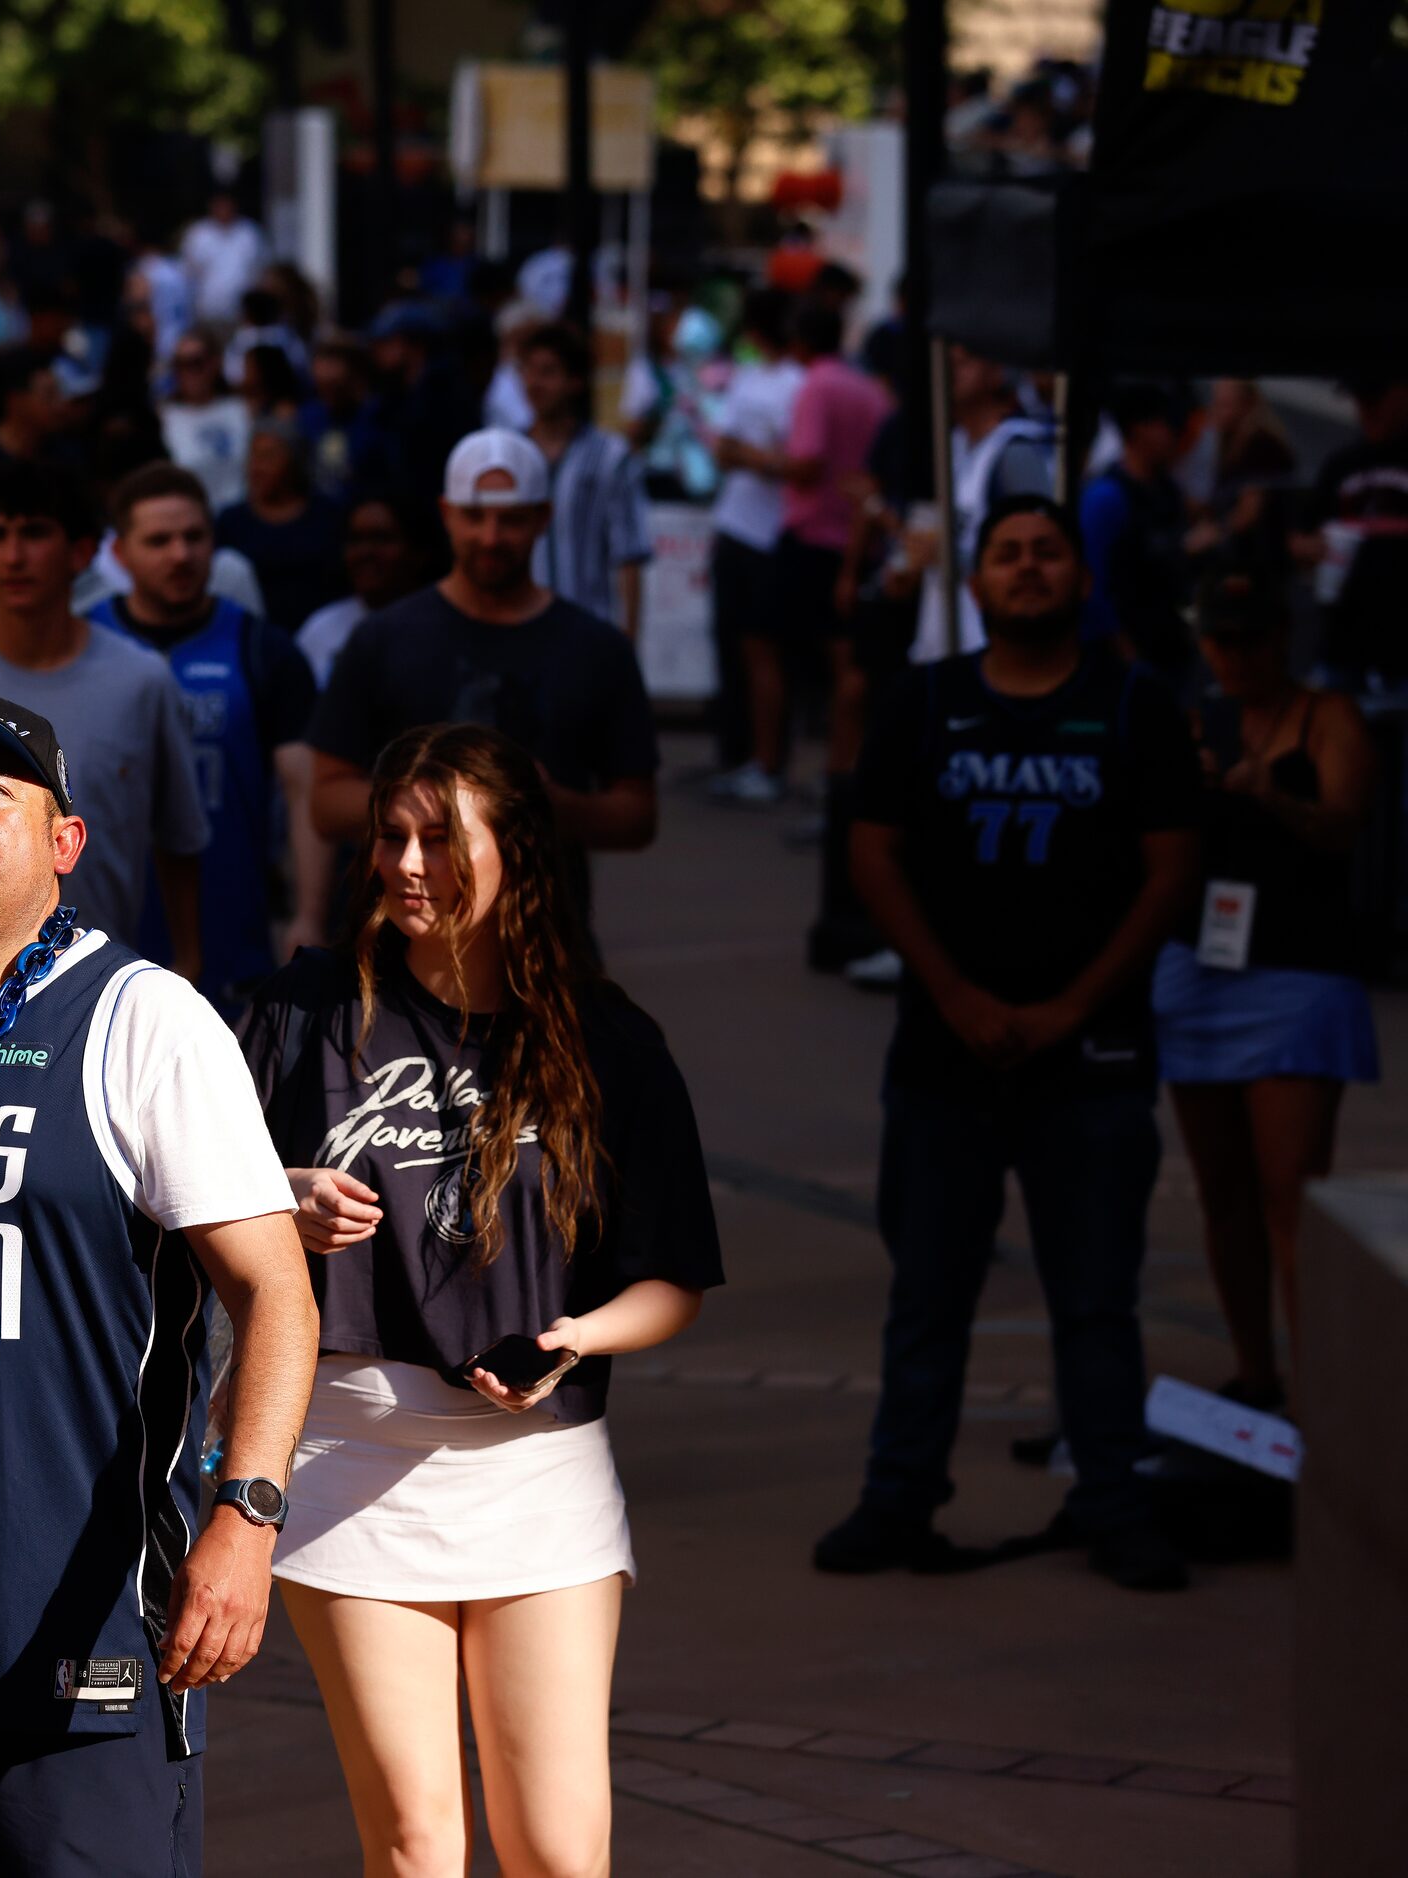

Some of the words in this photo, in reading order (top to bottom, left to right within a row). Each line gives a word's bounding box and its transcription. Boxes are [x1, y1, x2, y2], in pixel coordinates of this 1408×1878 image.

[937, 750, 1103, 809] MAVS
[968, 801, 1061, 865] 77
[313, 1114, 539, 1172] Maveris
